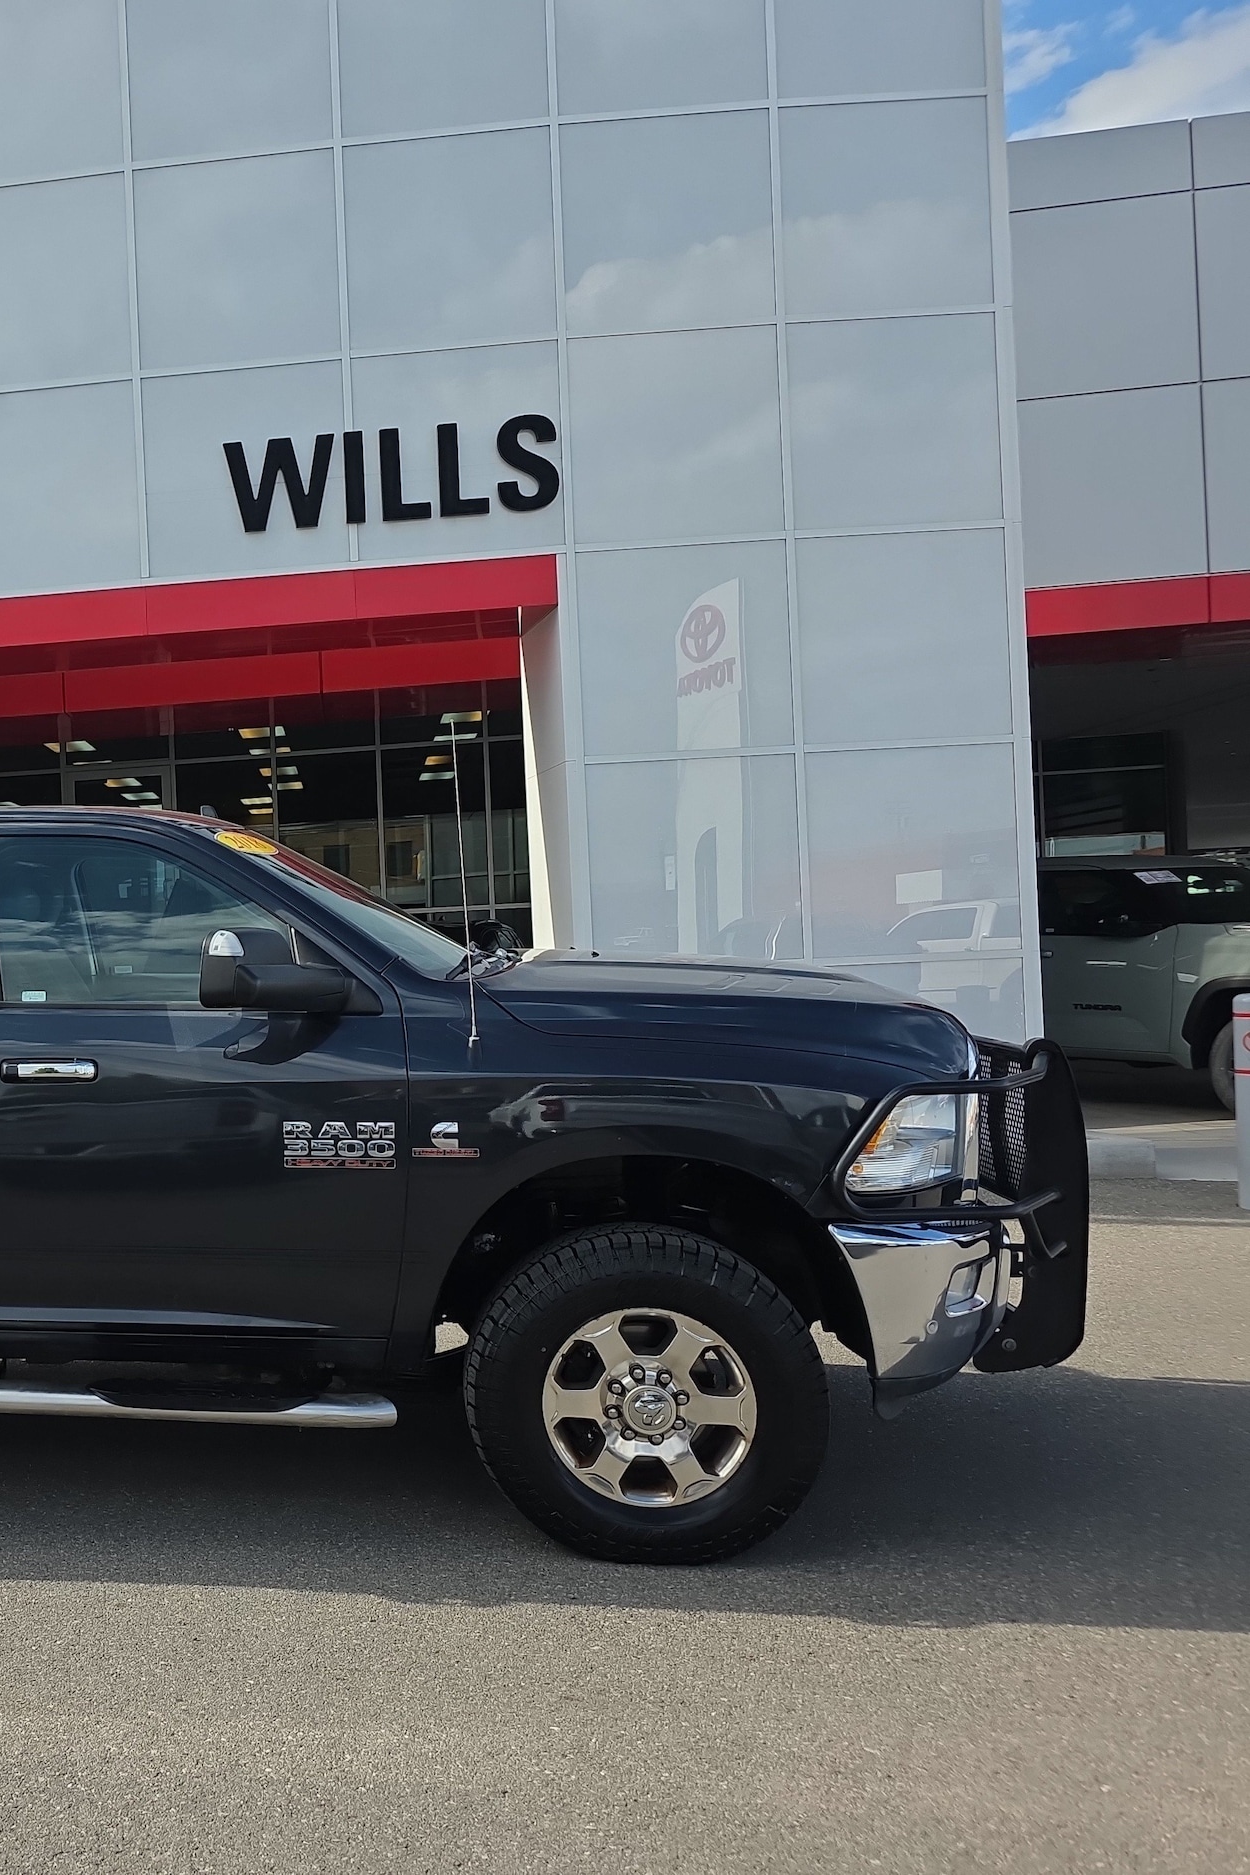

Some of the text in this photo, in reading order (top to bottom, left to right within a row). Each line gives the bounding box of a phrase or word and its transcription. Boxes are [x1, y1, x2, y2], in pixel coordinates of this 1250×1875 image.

[222, 413, 560, 533] WILLS
[282, 1121, 395, 1139] RAM
[283, 1139, 396, 1158] 3500
[288, 1159, 392, 1168] HEAVY DUTY
